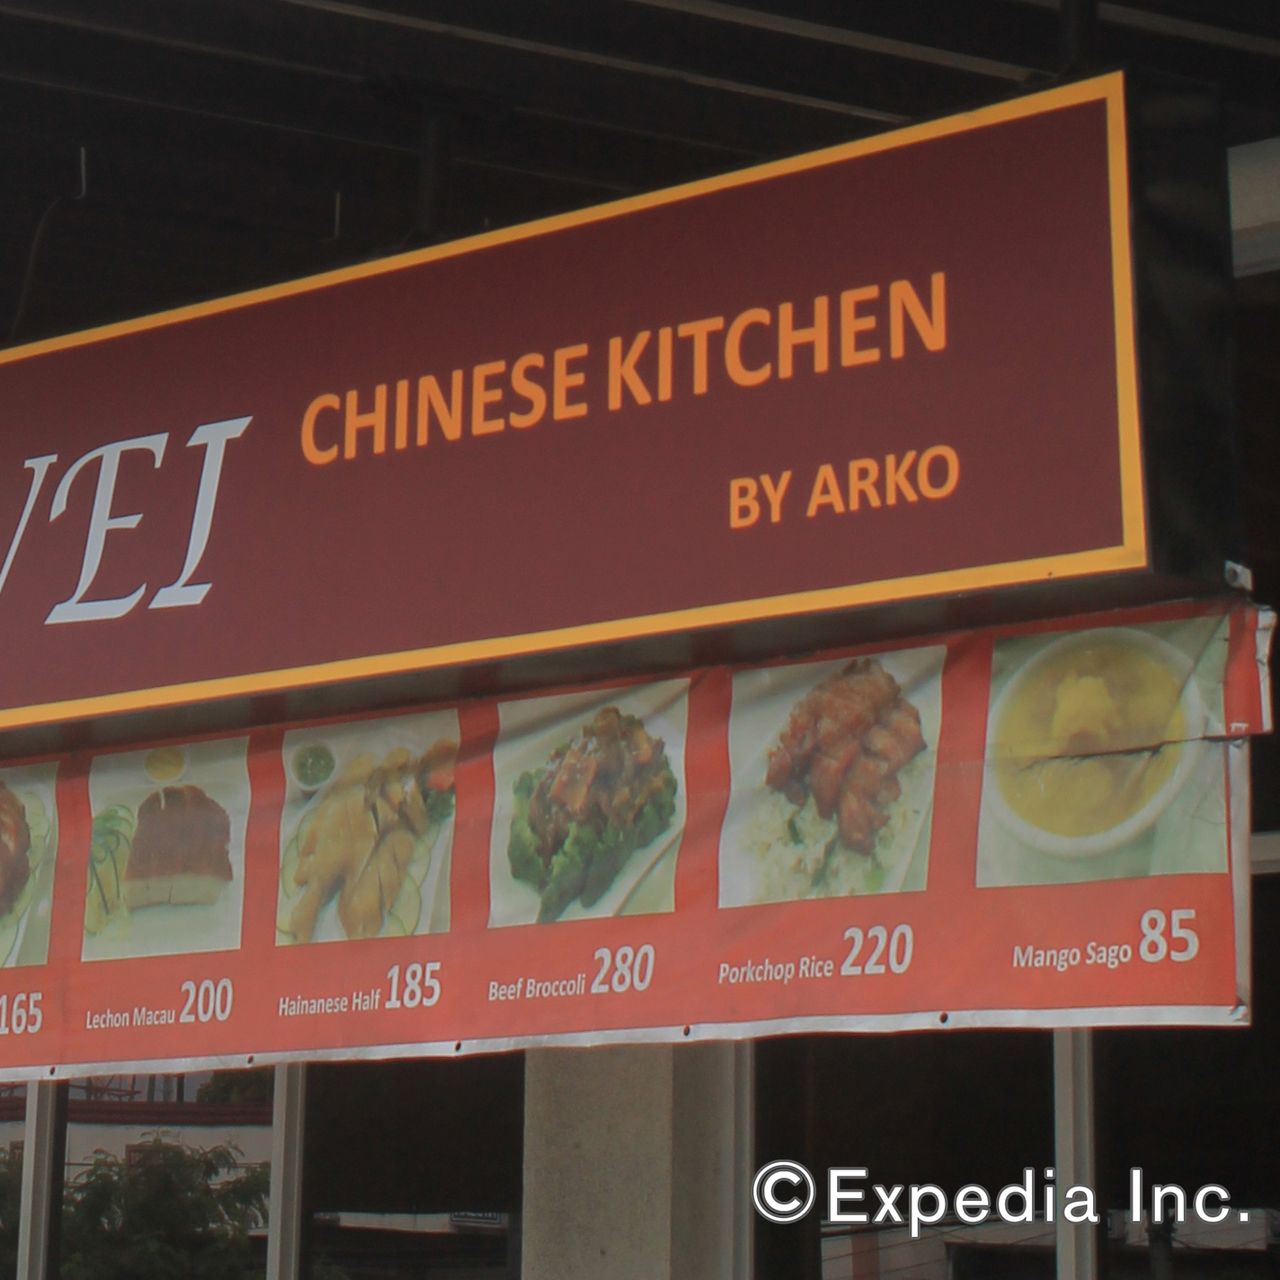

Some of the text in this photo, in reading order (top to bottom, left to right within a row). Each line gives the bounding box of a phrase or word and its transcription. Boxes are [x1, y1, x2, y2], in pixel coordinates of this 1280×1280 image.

[300, 272, 946, 465] CHINESE KITCHEN
[729, 444, 960, 529] BY ARKO
[717, 923, 914, 985] Porkchop Rice 220
[1011, 907, 1200, 973] Mango Sago 85
[278, 961, 442, 1017] Hainanese Half 185
[488, 943, 656, 1002] Beef Broccoli 280
[85, 978, 233, 1030] Lechon Macau 200
